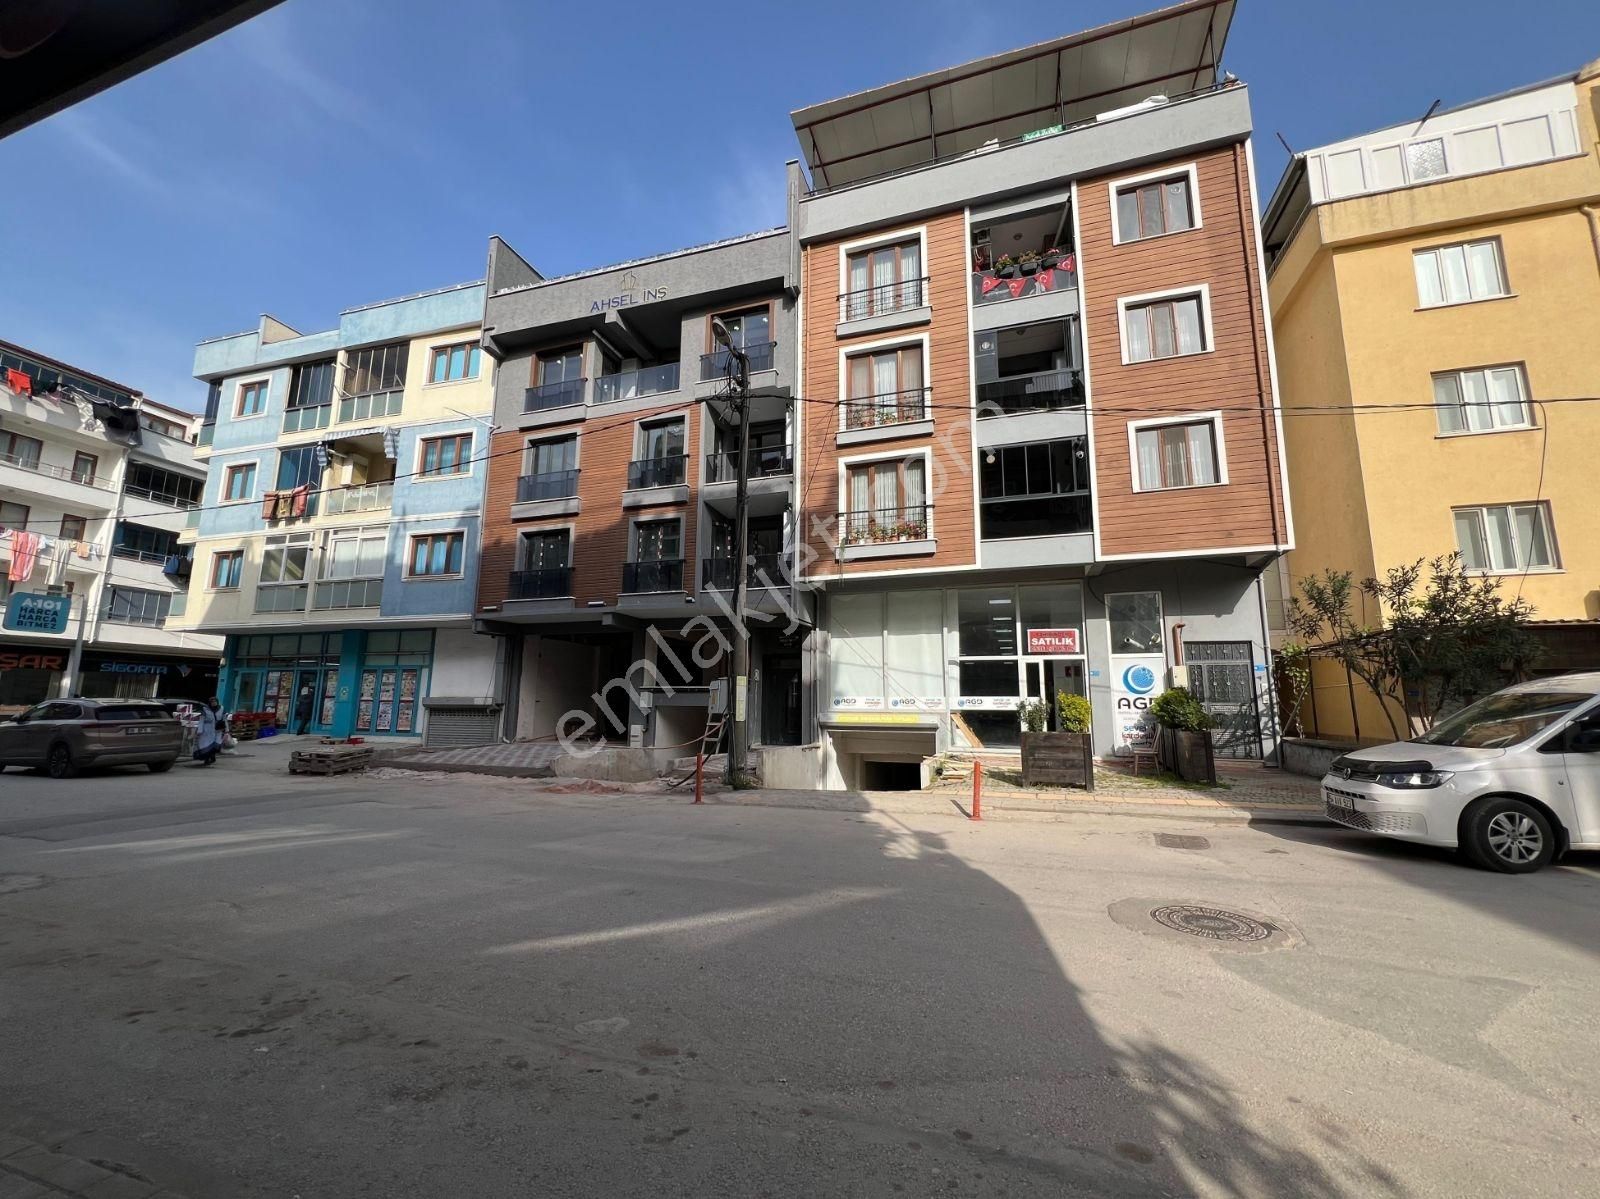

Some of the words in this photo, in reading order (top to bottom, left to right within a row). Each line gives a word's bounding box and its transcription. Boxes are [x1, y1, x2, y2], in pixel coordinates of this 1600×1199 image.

[590, 293, 639, 313] AHSEL
[21, 597, 62, 611] A-101
[20, 606, 59, 617] HARCA
[18, 613, 57, 624] HARCA
[1031, 637, 1074, 646] SATILIK
[100, 661, 168, 674] SİGORTA
[1117, 697, 1153, 710] AG
